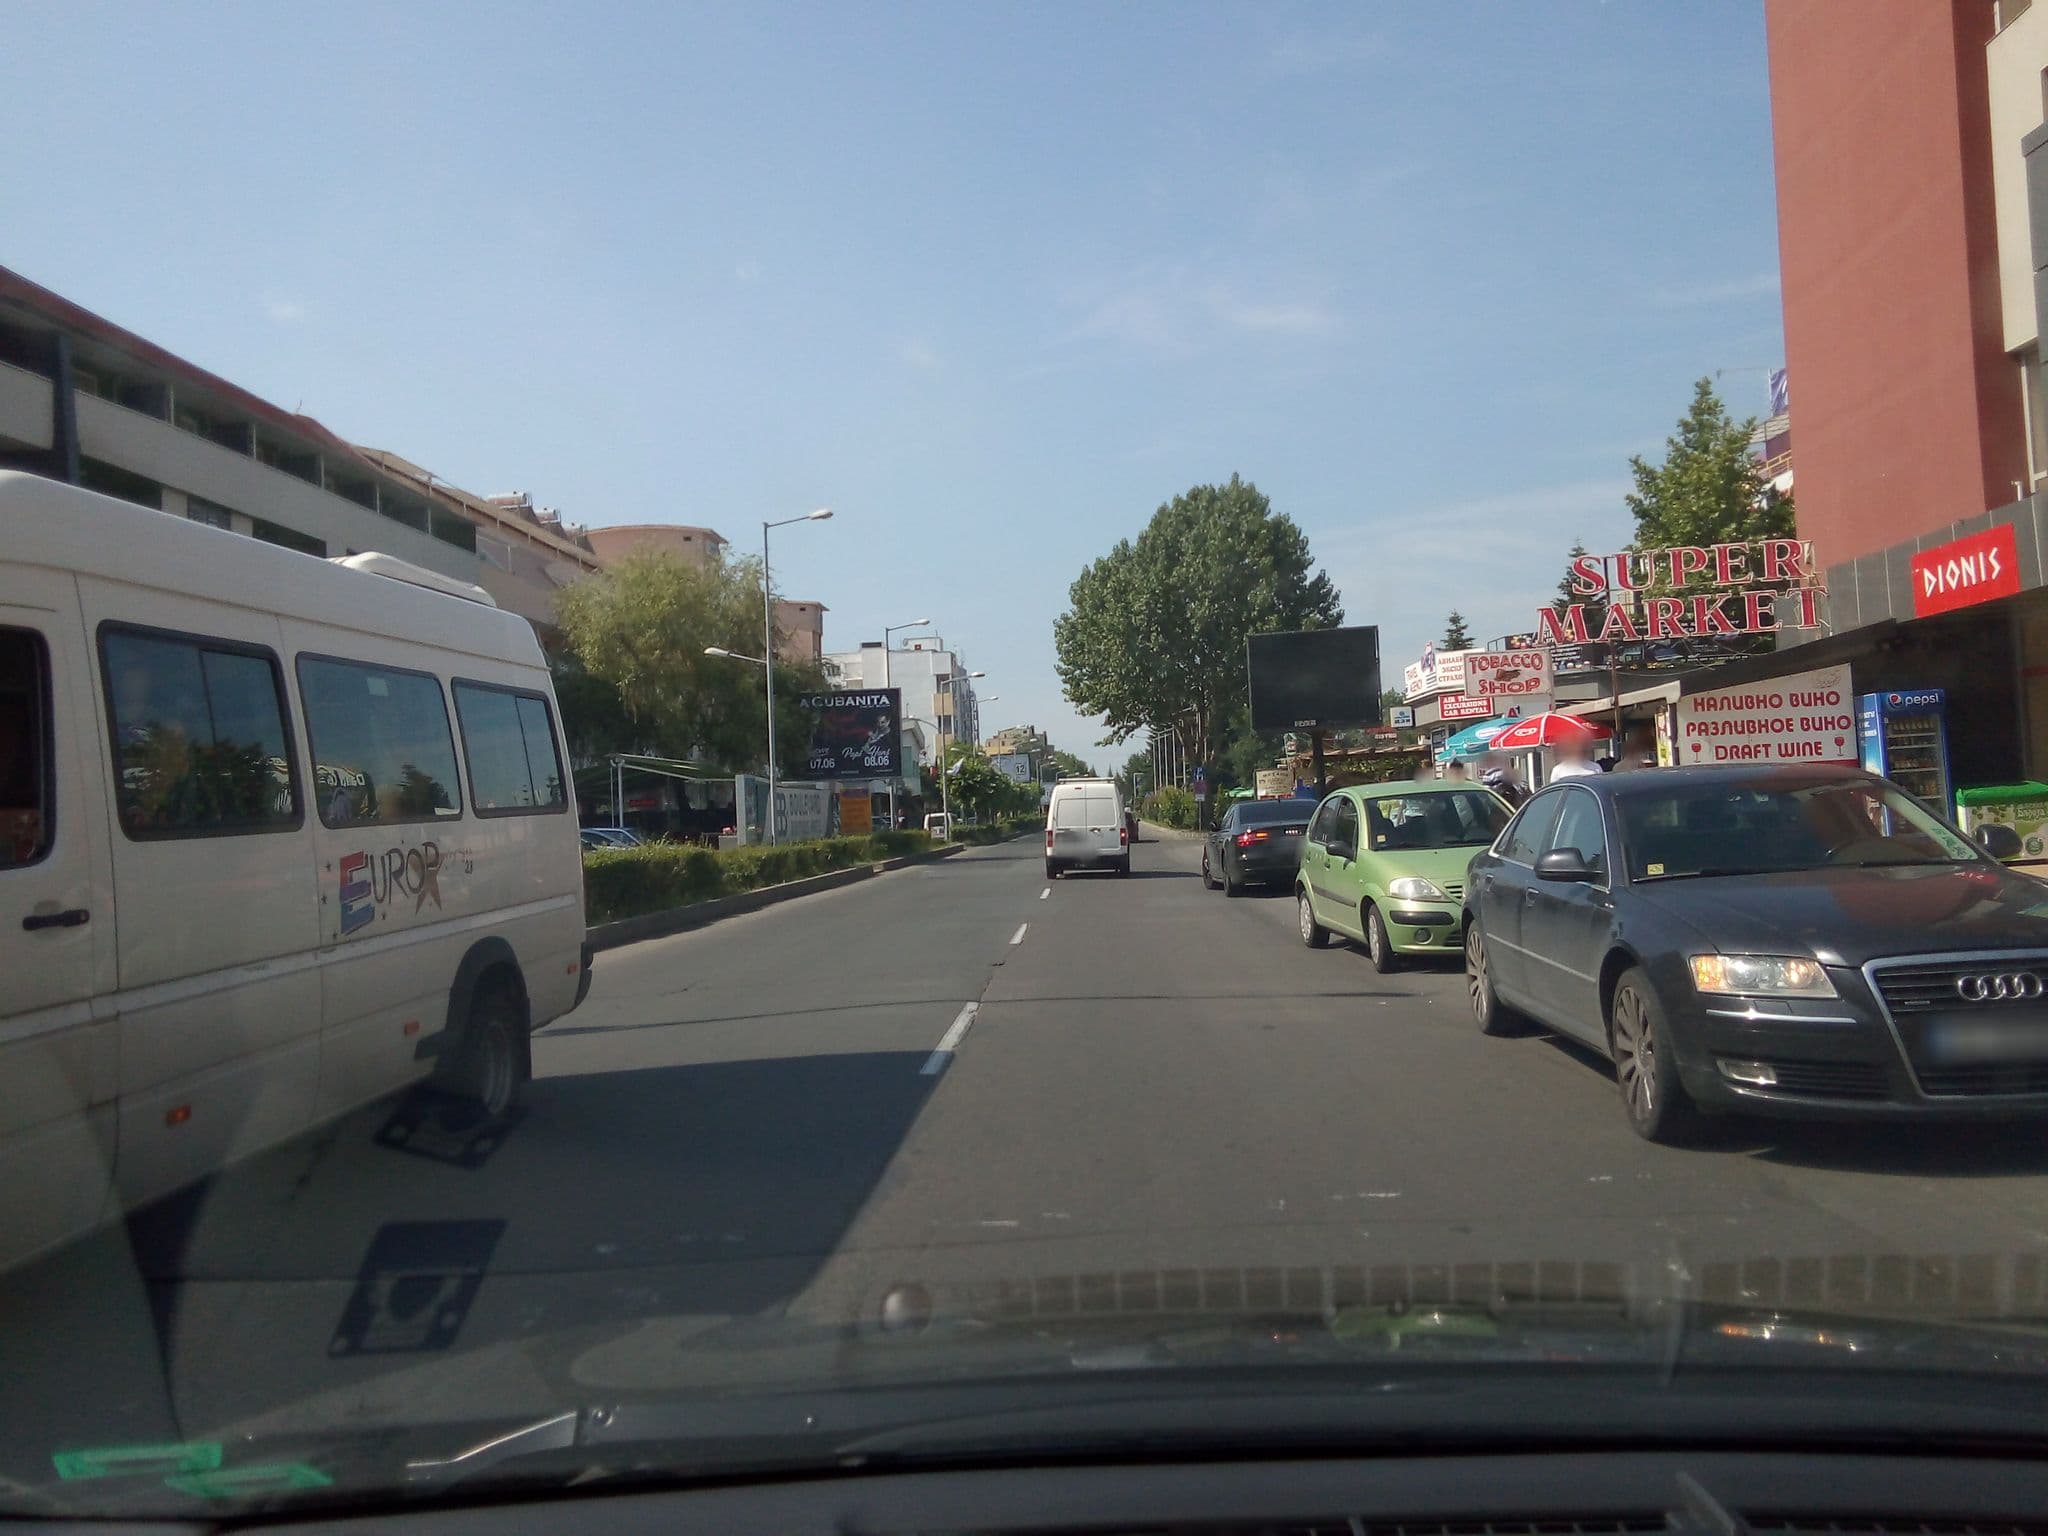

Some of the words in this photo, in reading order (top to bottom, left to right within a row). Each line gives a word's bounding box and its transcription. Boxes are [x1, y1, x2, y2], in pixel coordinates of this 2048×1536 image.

[1571, 537, 1815, 596] SUPER
[1923, 547, 2001, 598] DIONIS
[1536, 586, 1830, 646] MARKET
[1469, 652, 1543, 674] TOBACCO
[1478, 677, 1541, 695] SHOP
[812, 695, 890, 707] CUBANITA
[1693, 693, 1783, 712] НАЛИВНО
[1789, 690, 1841, 708] ВИНО
[1905, 693, 1939, 707] pepsi
[1460, 707, 1489, 715] RENTAL
[1686, 717, 1794, 737] РАЗЛИВНОЕ
[1799, 715, 1851, 731] ВИНО
[1715, 743, 1771, 760] DRAFT
[1777, 741, 1823, 758] WINE
[810, 758, 835, 769] 07.06
[864, 756, 890, 767] 08.06
